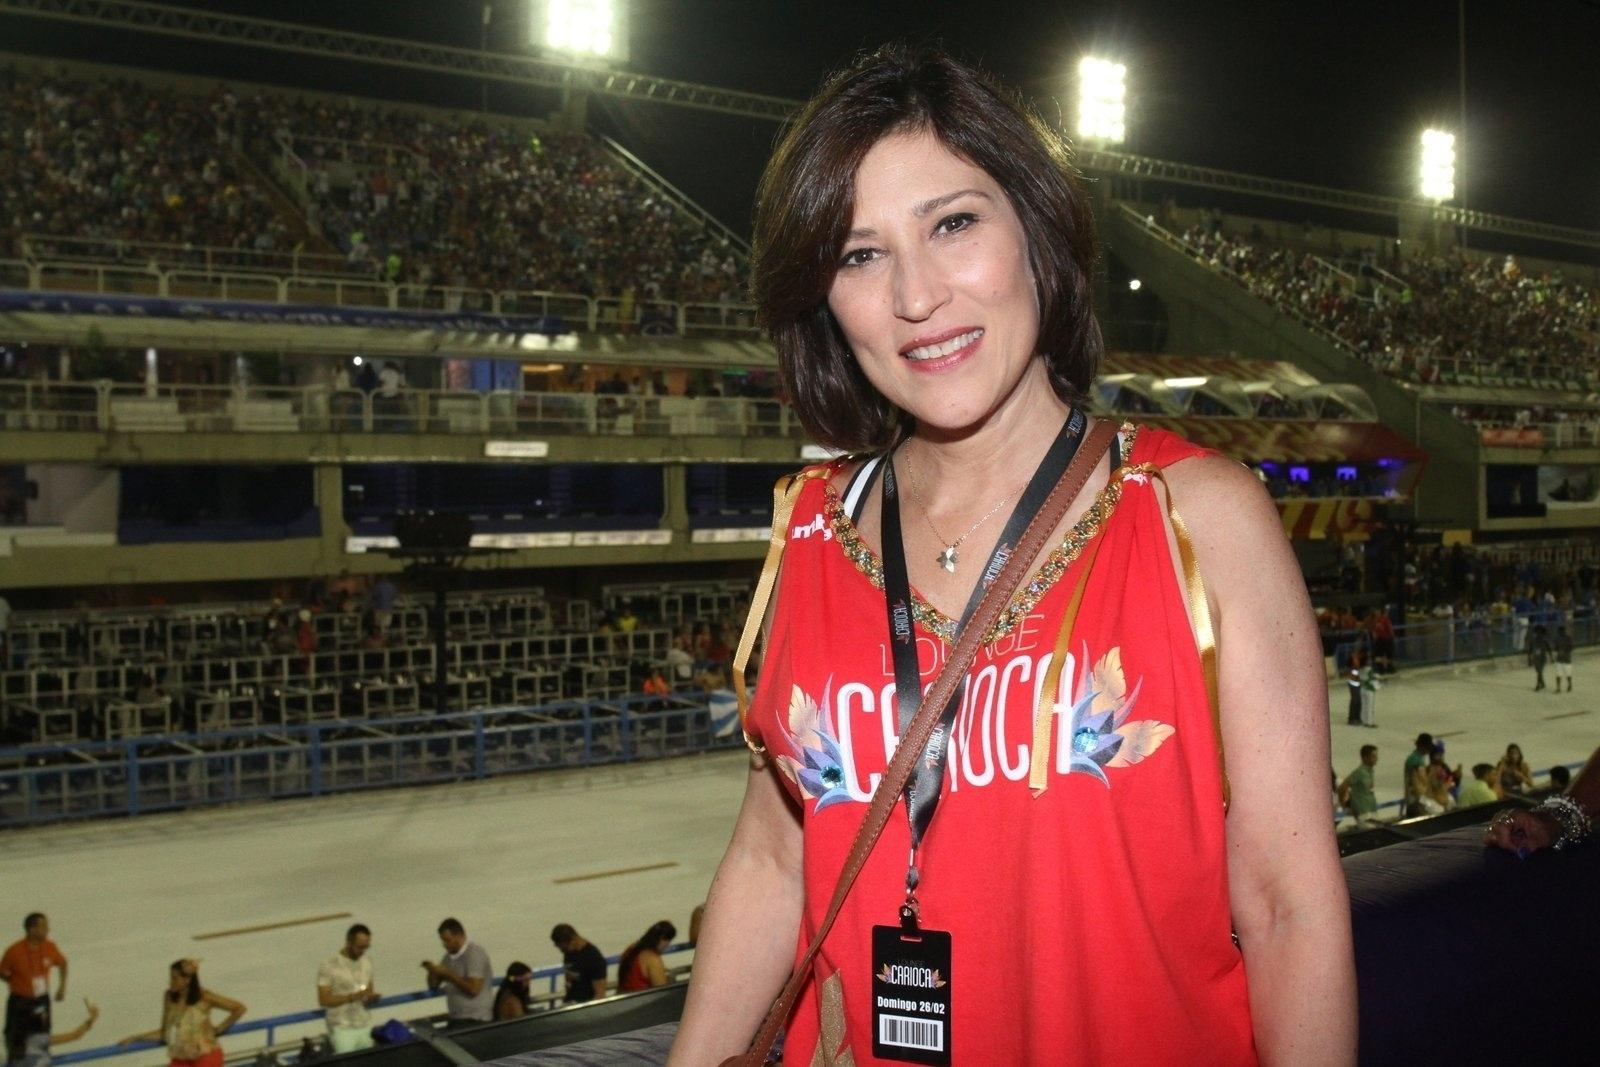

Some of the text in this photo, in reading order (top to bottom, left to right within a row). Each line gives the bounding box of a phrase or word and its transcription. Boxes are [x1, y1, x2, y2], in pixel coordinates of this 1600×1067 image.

[896, 604, 911, 637] CARIOCA
[880, 613, 1045, 677] LOGE
[837, 652, 1075, 802] CIOCA
[925, 727, 944, 761] CARIOCA
[891, 965, 931, 988] CARIOCA
[877, 996, 945, 1014] Domingo 26/02
